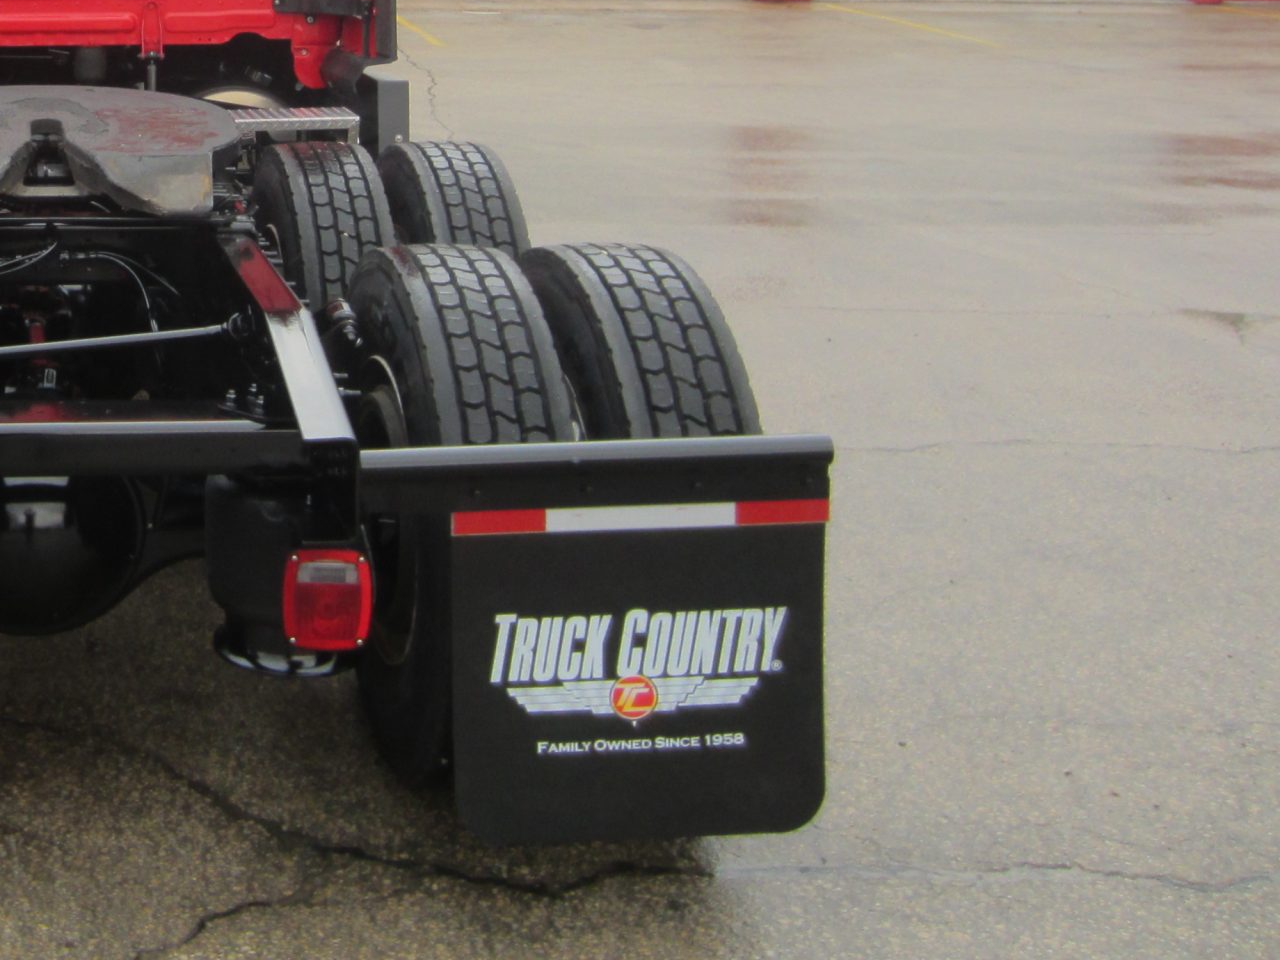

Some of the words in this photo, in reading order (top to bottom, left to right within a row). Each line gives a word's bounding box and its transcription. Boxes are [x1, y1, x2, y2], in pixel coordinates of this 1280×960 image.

[490, 613, 612, 683] TRUCK
[537, 740, 591, 754] FAMILY
[594, 738, 652, 751] OWNED
[655, 735, 700, 749] SINCE
[704, 733, 745, 746] 1958
